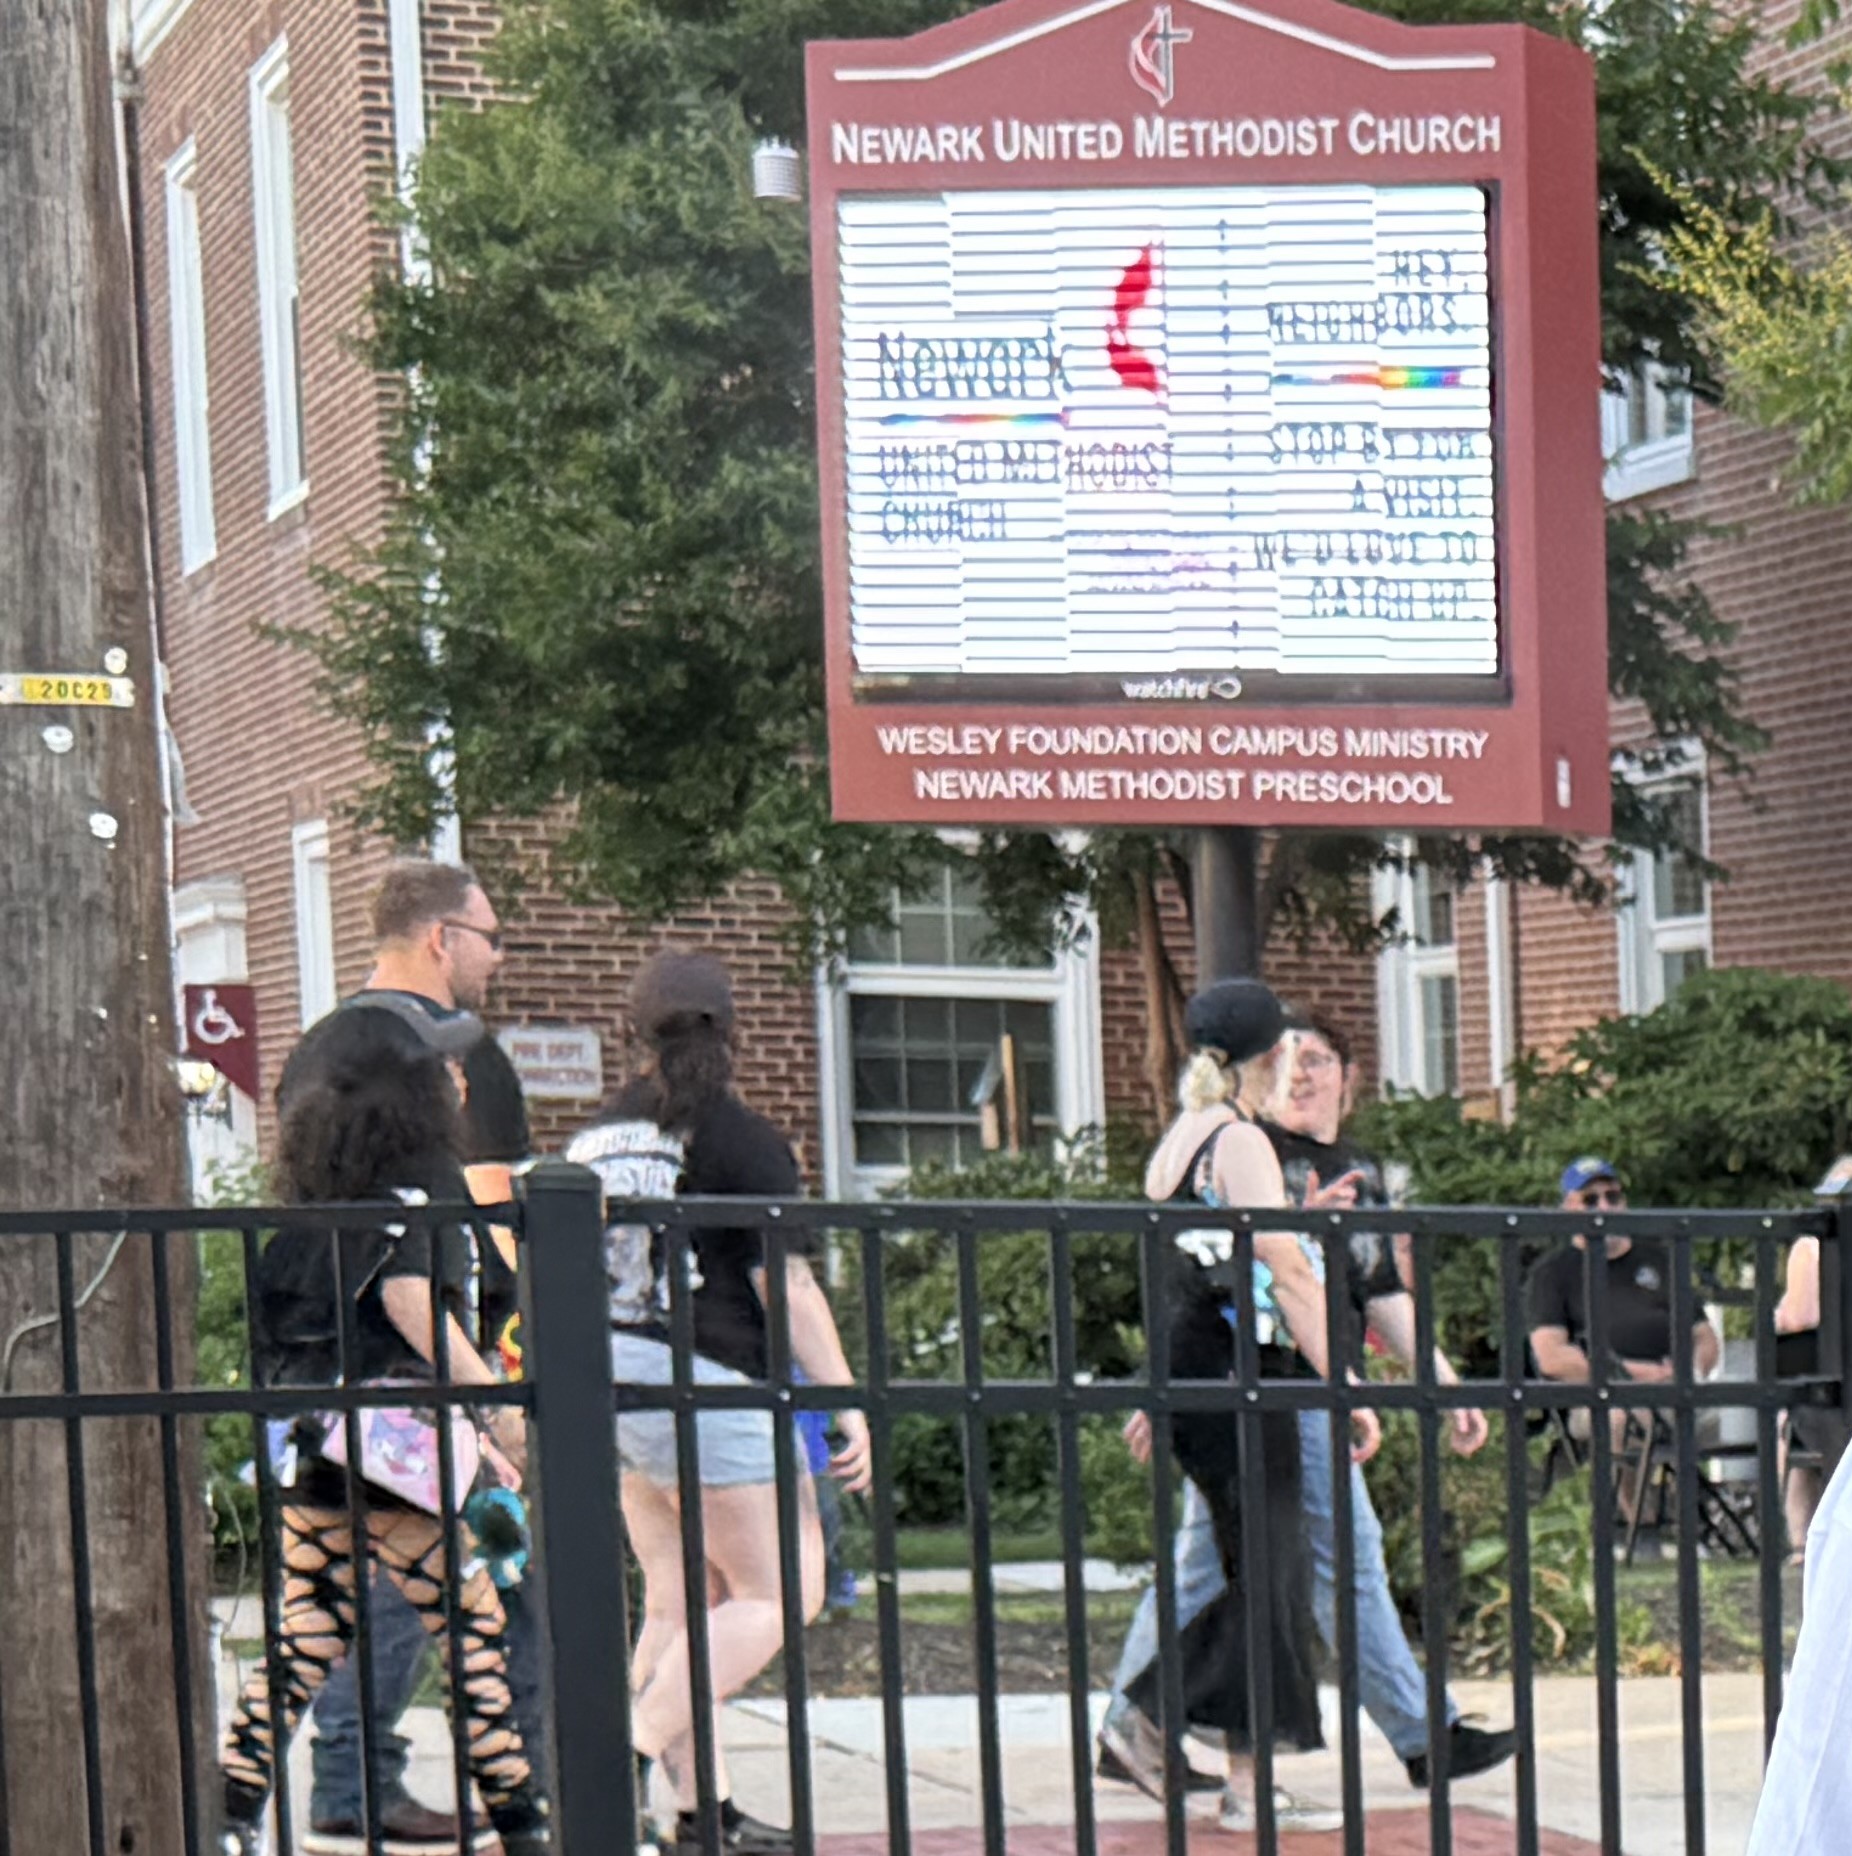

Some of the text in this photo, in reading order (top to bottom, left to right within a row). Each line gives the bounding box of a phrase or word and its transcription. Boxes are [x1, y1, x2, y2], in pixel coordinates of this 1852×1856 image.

[831, 111, 1501, 163] NEWARK UNITED METHODIST CHURCH
[877, 726, 1489, 760] WESLEY FOUNDATION CAMPUS MINISTRY
[915, 768, 1454, 805] NEWARK METHODIST PRESCHOOL
